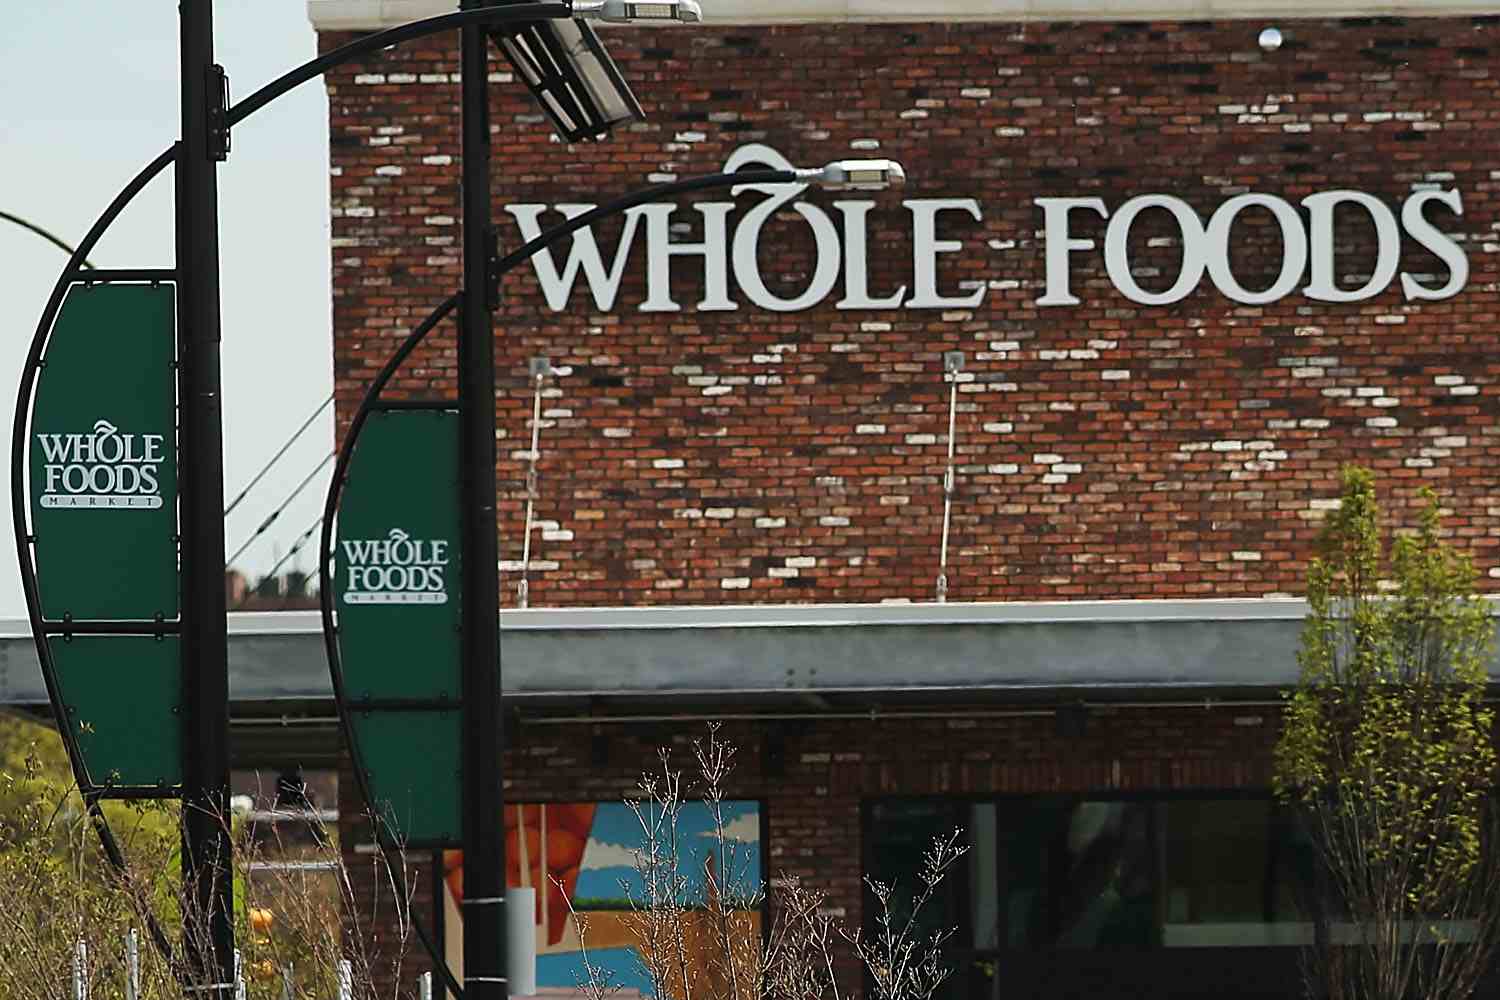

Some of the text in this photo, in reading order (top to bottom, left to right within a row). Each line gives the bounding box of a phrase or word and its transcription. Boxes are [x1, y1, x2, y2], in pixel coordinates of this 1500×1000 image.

[503, 143, 987, 312] WHOLE
[1035, 186, 1470, 308] FOODS
[36, 419, 165, 463] WHOLE
[44, 464, 160, 494] FOODS
[49, 497, 153, 505] MARKET
[341, 528, 449, 565] WHOLE
[347, 566, 445, 591] FOODS
